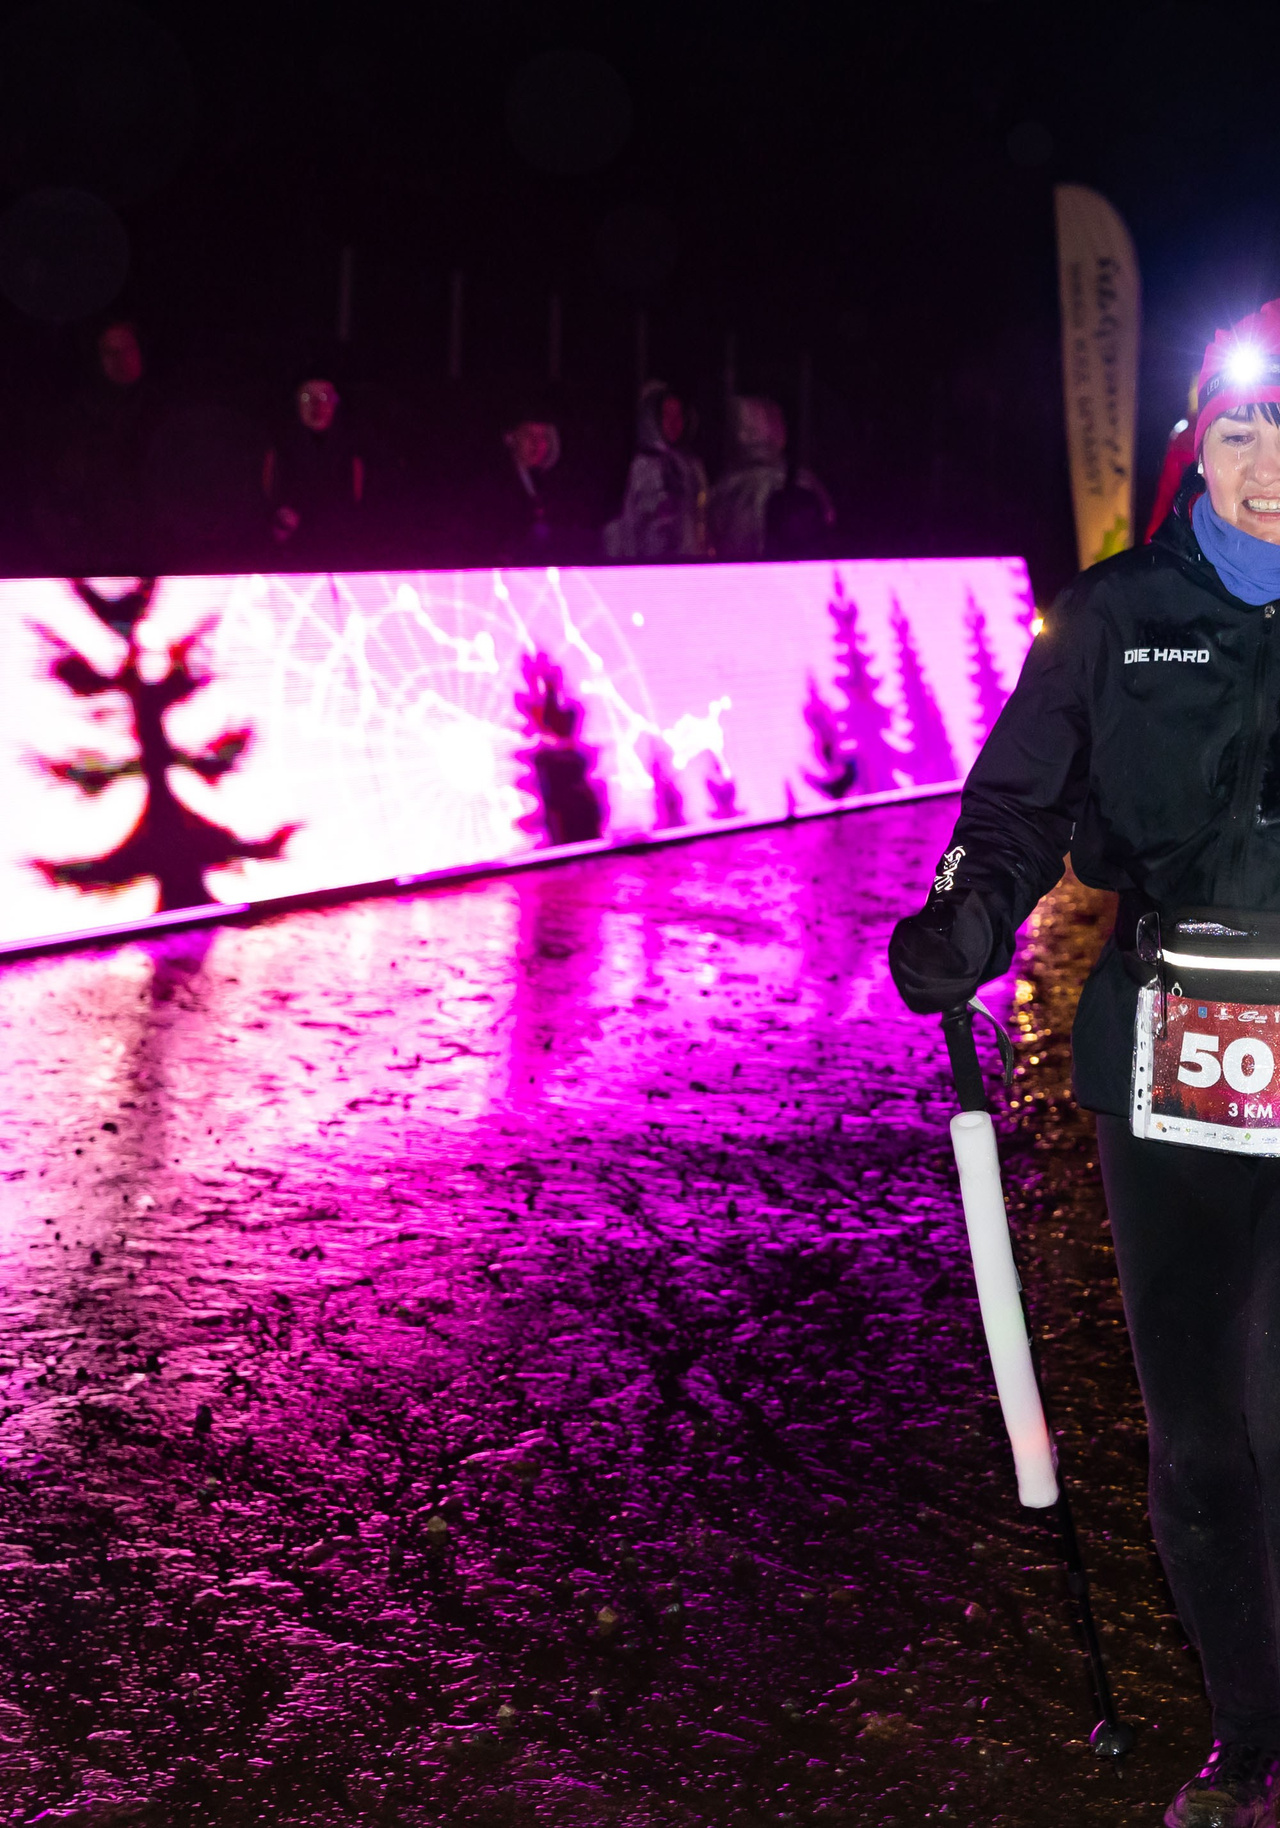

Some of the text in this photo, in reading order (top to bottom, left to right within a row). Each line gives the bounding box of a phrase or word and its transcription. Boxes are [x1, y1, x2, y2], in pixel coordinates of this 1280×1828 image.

[1123, 648, 1210, 665] DIE HARD
[1228, 1102, 1273, 1119] 3 KM
